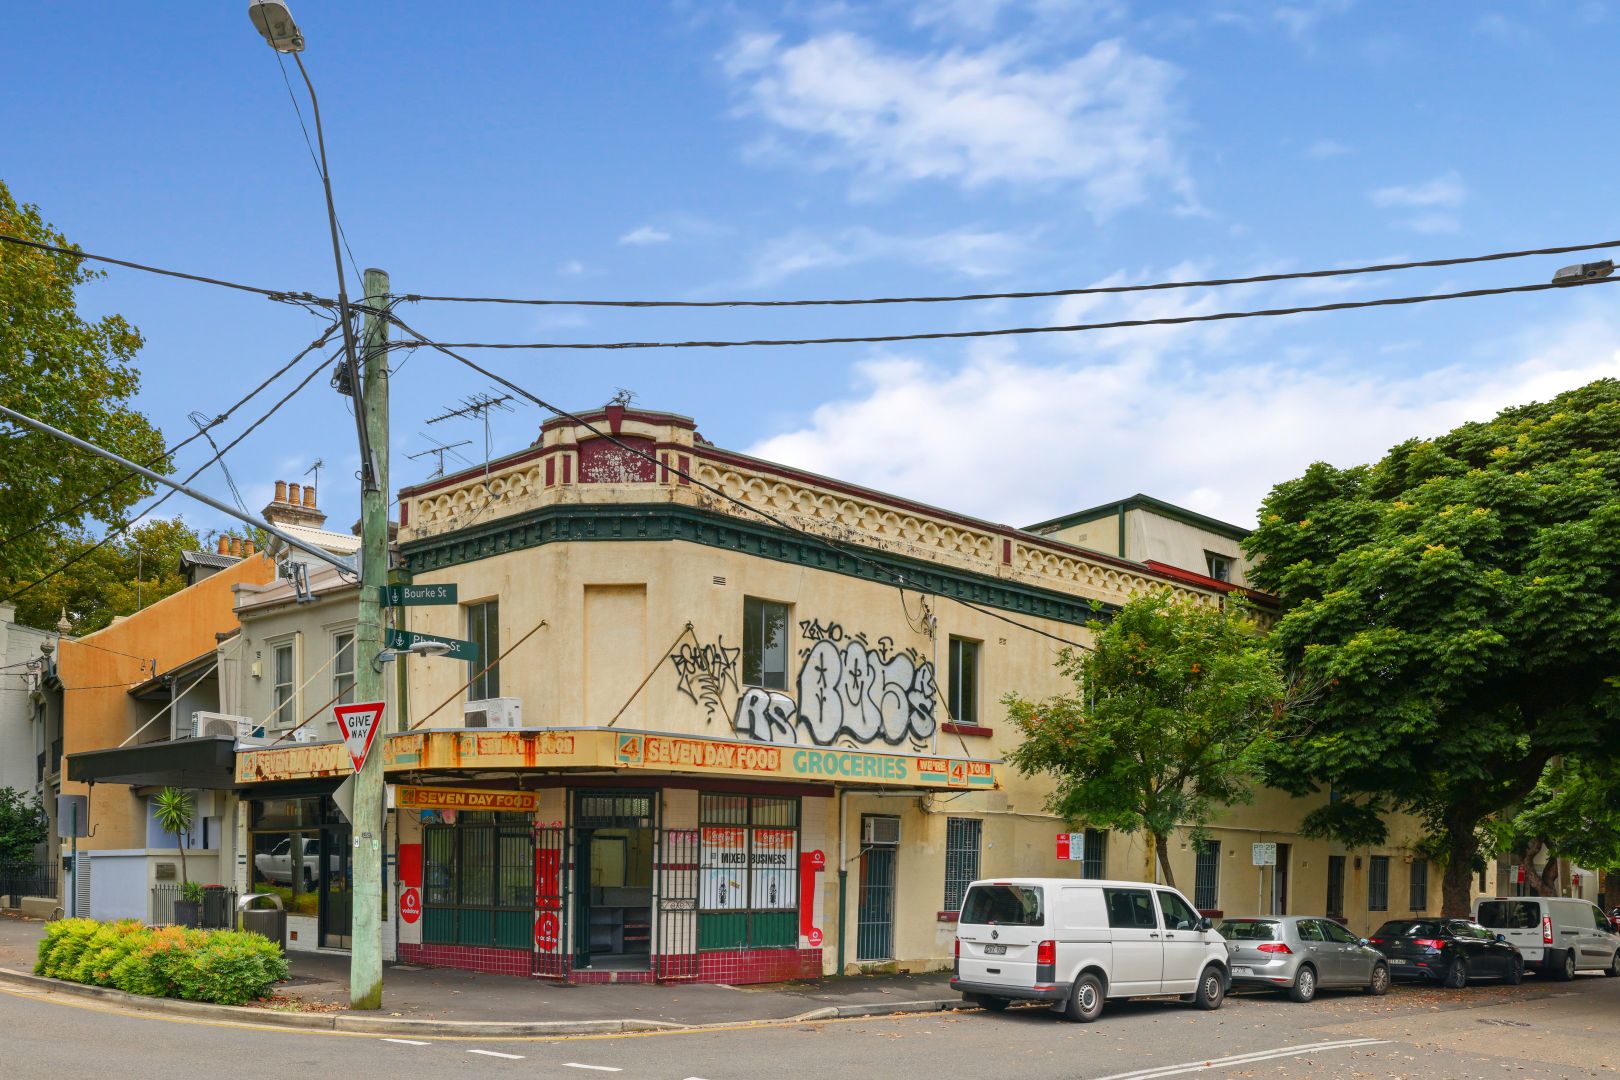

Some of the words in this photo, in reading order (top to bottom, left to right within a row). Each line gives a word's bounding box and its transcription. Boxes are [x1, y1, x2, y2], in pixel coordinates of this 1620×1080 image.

[404, 587, 436, 599] Bourke
[437, 586, 447, 598] St
[450, 641, 461, 652] St
[348, 715, 371, 728] GIVE
[351, 729, 368, 739] WAY
[620, 737, 640, 762] 4
[649, 739, 703, 766] SEVEN
[704, 745, 734, 768] DAY
[737, 747, 779, 770] FOOD
[792, 750, 908, 780] GROCERIES
[969, 763, 987, 775] YOU
[419, 791, 465, 805] SEVEN
[468, 793, 494, 806] DAY
[496, 794, 532, 807] FOOD
[721, 852, 746, 864] MIXED
[751, 853, 787, 865] BUSINESS
